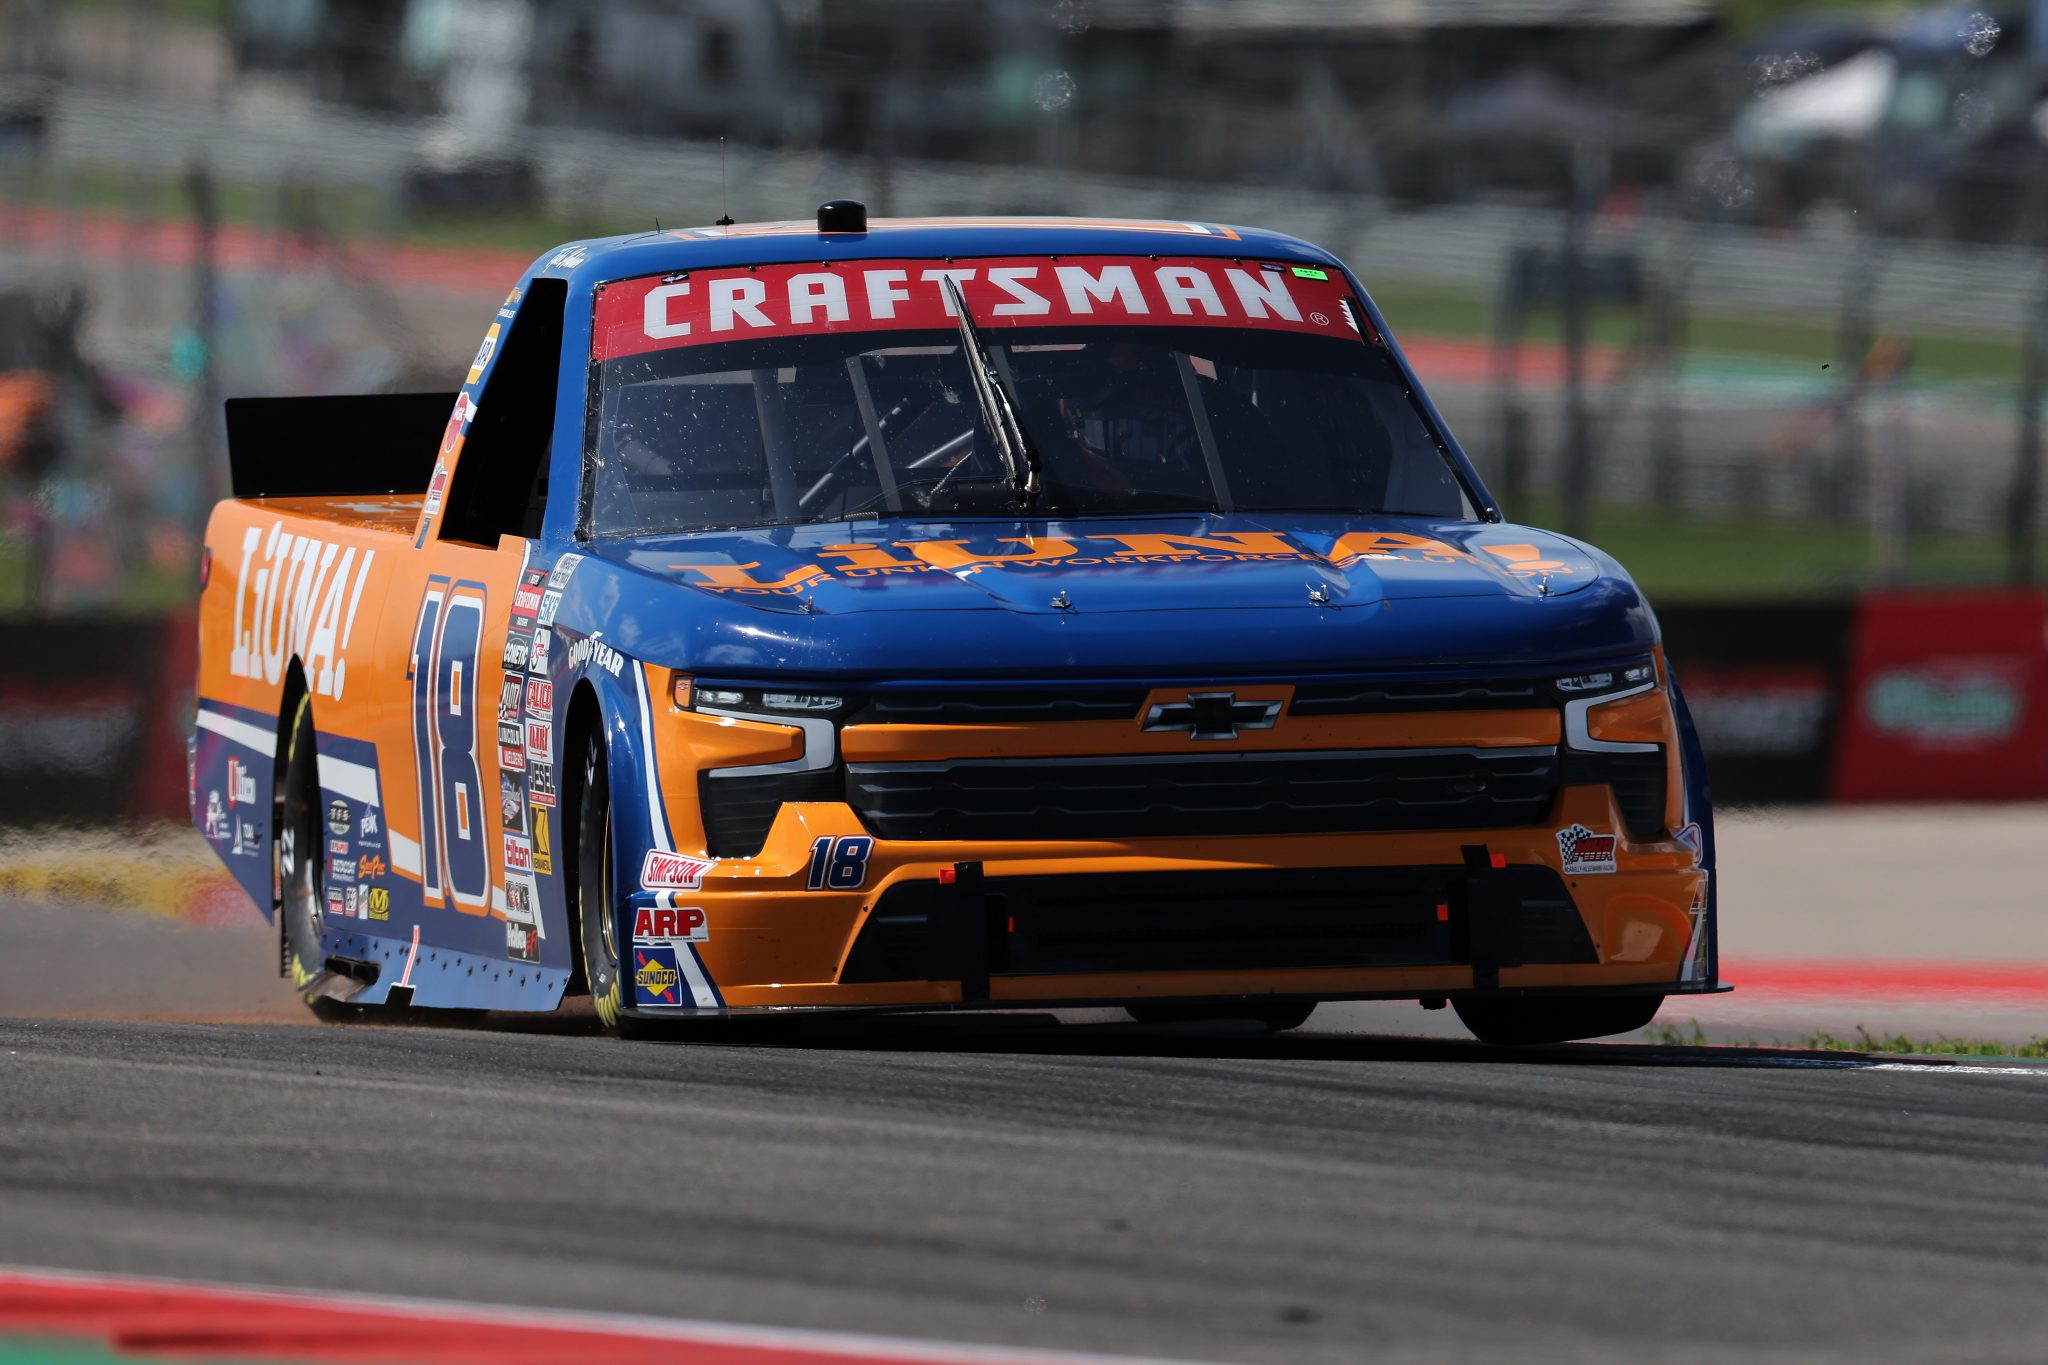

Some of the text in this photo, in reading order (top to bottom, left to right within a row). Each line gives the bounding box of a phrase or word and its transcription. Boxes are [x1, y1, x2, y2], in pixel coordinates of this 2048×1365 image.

[643, 265, 1304, 339] CRAFTSMAN
[702, 573, 834, 596] YOUR
[846, 562, 1004, 577] UNIN
[538, 594, 560, 621] SKF
[504, 641, 528, 665] COMETIC
[502, 685, 520, 709] KLOTZ
[526, 681, 552, 710] CALICO
[408, 576, 491, 915] 18
[499, 725, 521, 745] LINCOLN
[530, 763, 555, 794] JESEL
[360, 813, 378, 838] PEAK
[647, 855, 704, 884] SIMPSON
[807, 835, 875, 891] 18
[635, 910, 704, 936] ARP
[637, 970, 675, 985] SUNOCO
